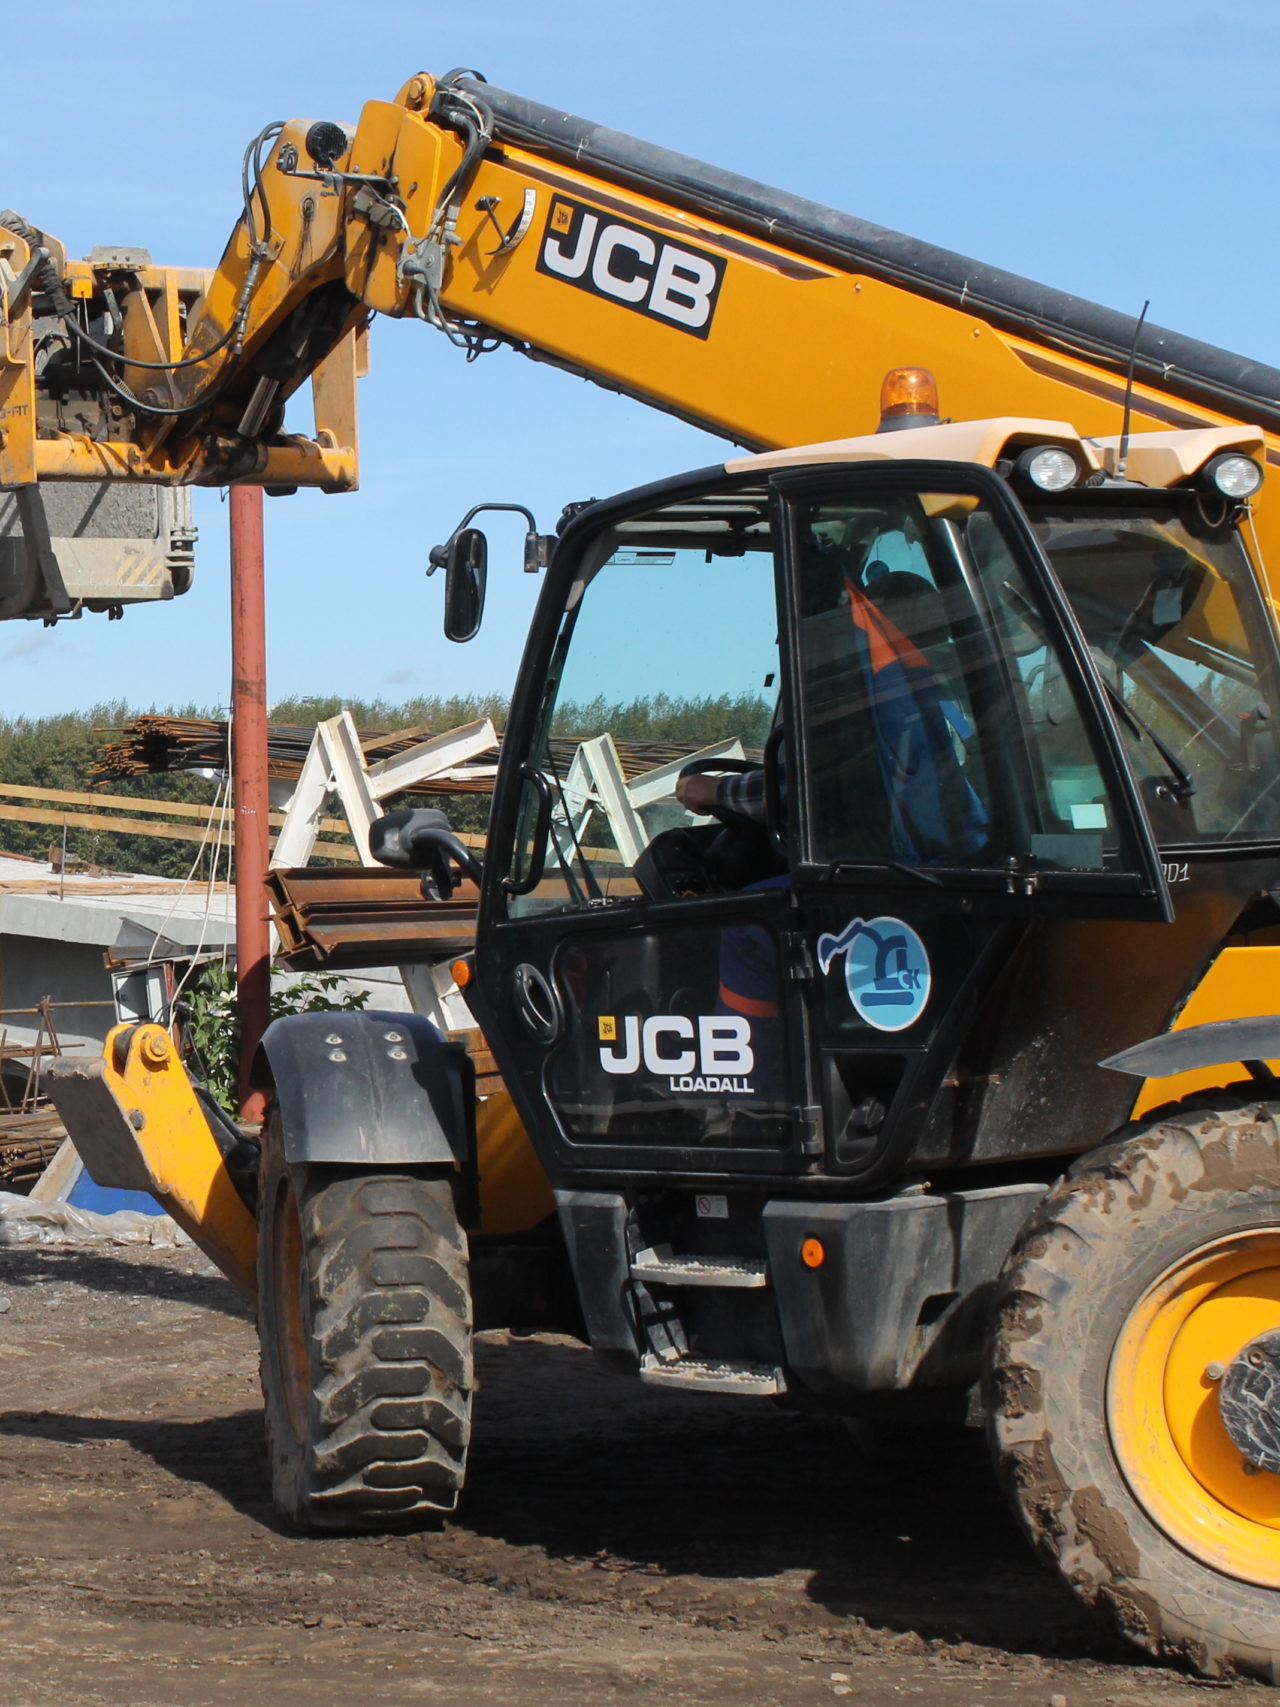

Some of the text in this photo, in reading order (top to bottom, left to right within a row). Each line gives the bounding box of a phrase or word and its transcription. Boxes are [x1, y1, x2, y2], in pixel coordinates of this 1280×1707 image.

[543, 213, 717, 328] JCB
[599, 1015, 754, 1075] JCB
[670, 1076, 755, 1094] LOADALL
